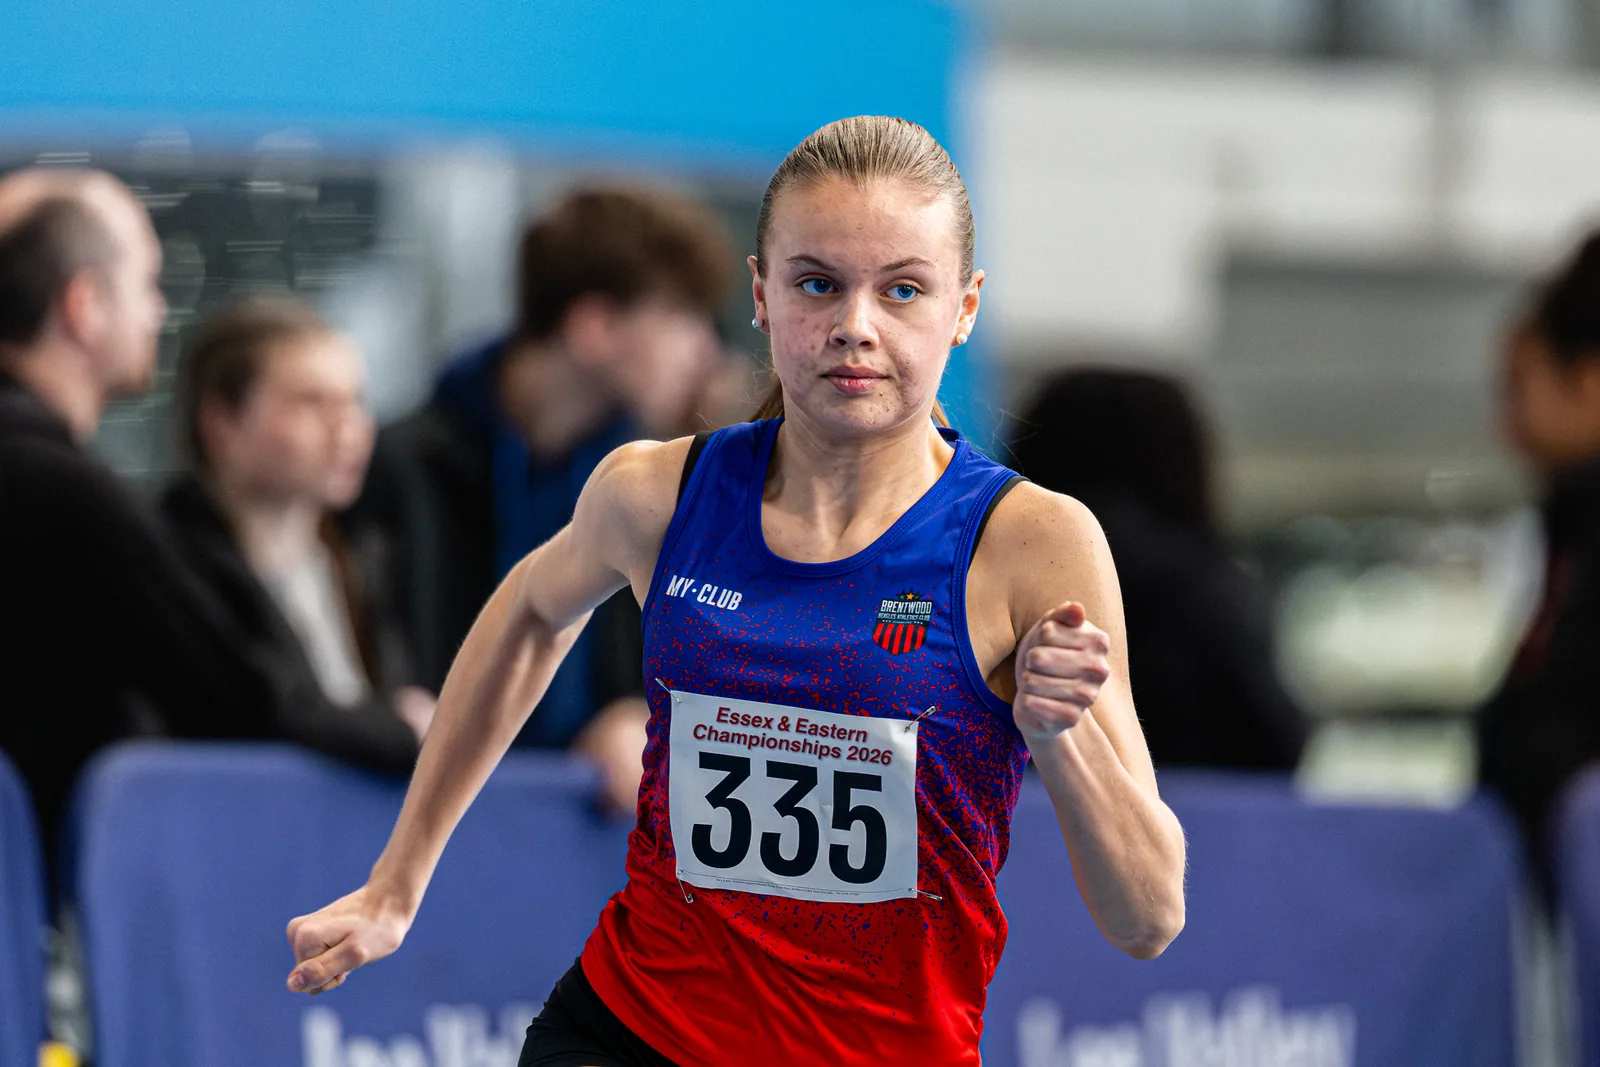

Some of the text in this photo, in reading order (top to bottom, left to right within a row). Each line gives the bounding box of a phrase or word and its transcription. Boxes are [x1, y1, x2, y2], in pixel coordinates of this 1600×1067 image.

[880, 600, 932, 614] BRENTWOOD
[693, 723, 893, 766] Championships 2026
[716, 706, 868, 743] Essex & Eastern
[691, 751, 887, 884] 335
